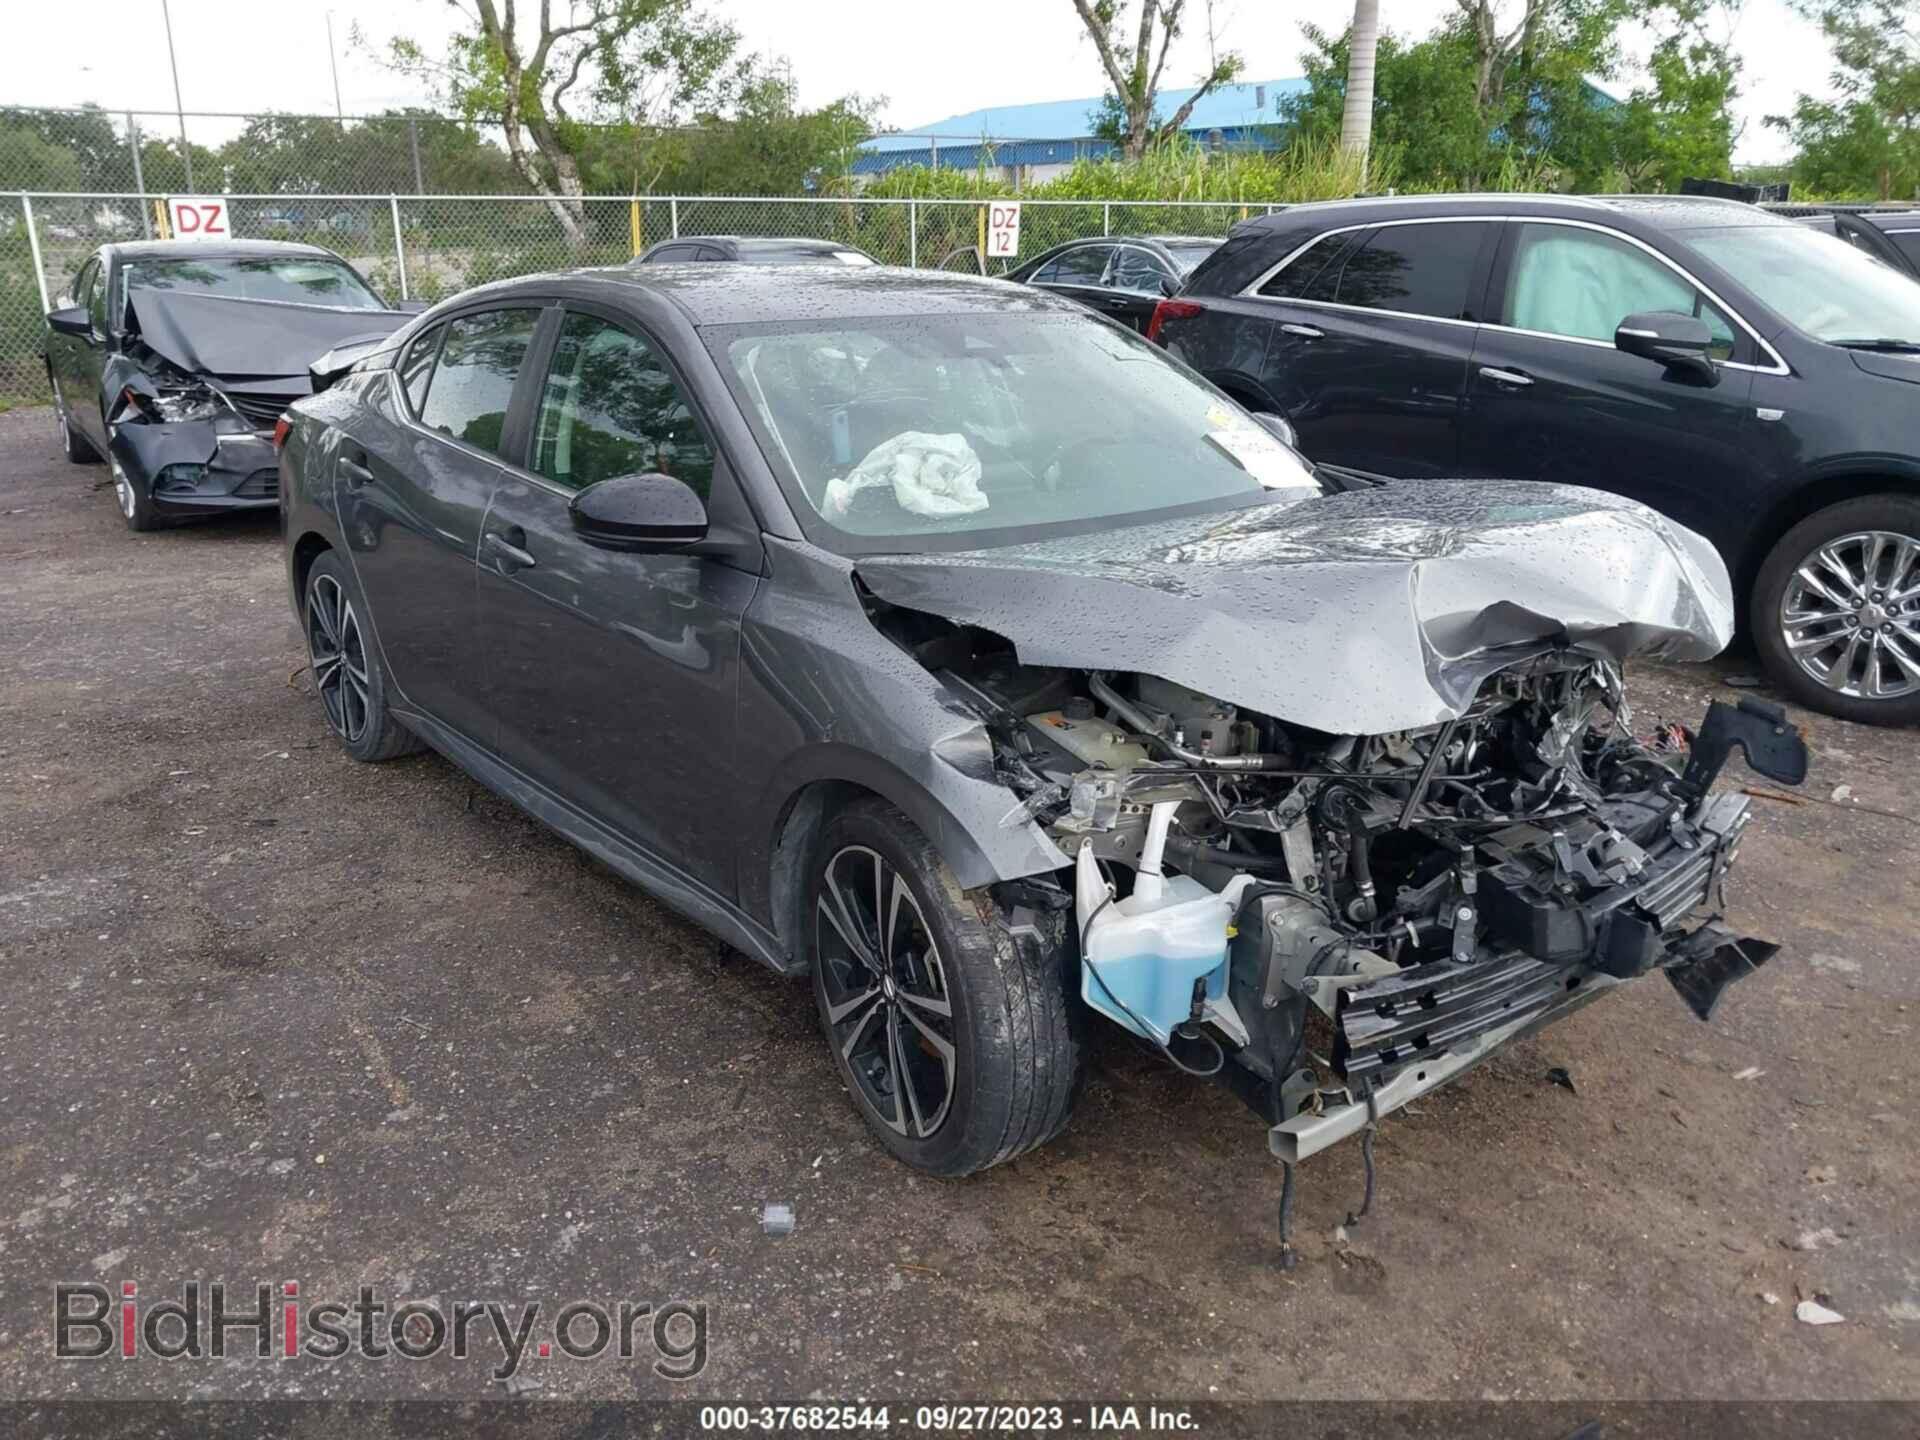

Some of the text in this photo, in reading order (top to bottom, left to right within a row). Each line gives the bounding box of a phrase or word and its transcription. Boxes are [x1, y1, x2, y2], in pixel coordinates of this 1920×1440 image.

[176, 205, 225, 233] DZ
[992, 208, 1017, 228] DZ
[996, 232, 1010, 253] 12
